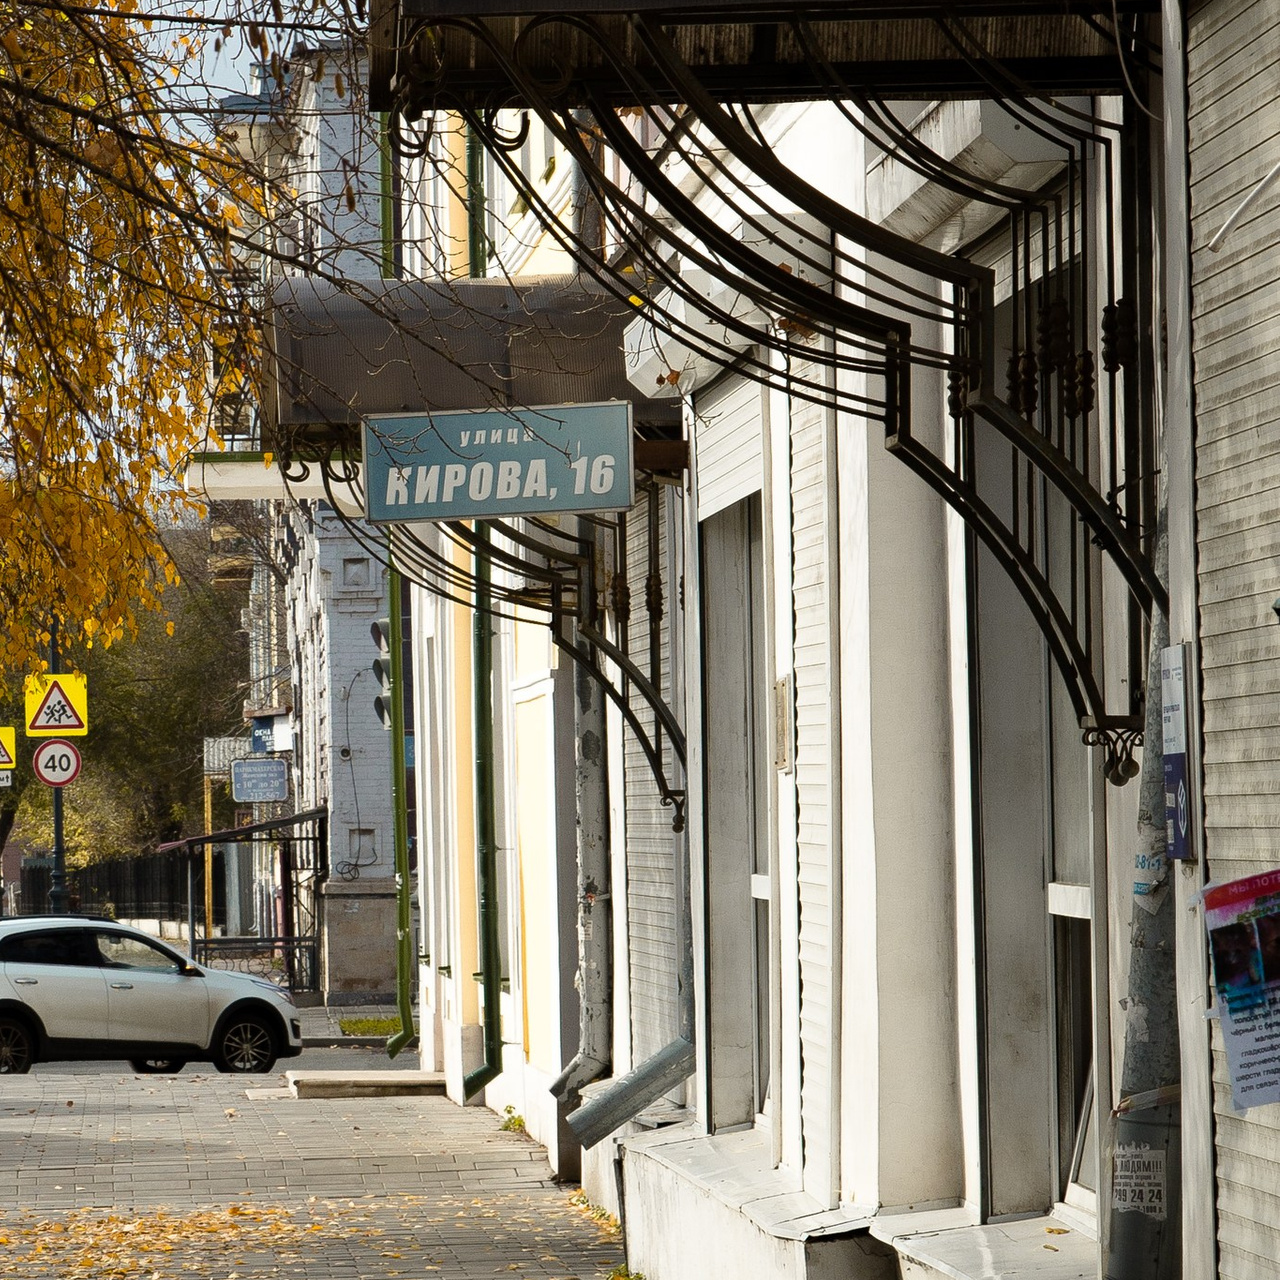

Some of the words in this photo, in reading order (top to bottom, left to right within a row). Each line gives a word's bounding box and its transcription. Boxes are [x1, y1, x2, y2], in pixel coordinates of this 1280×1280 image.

[460, 426, 535, 448] улица
[385, 458, 558, 506] КИРОВА,
[571, 454, 616, 495] 16
[43, 753, 71, 773] 40
[1130, 1188, 1144, 1203] 24
[1148, 1188, 1163, 1203] 24
